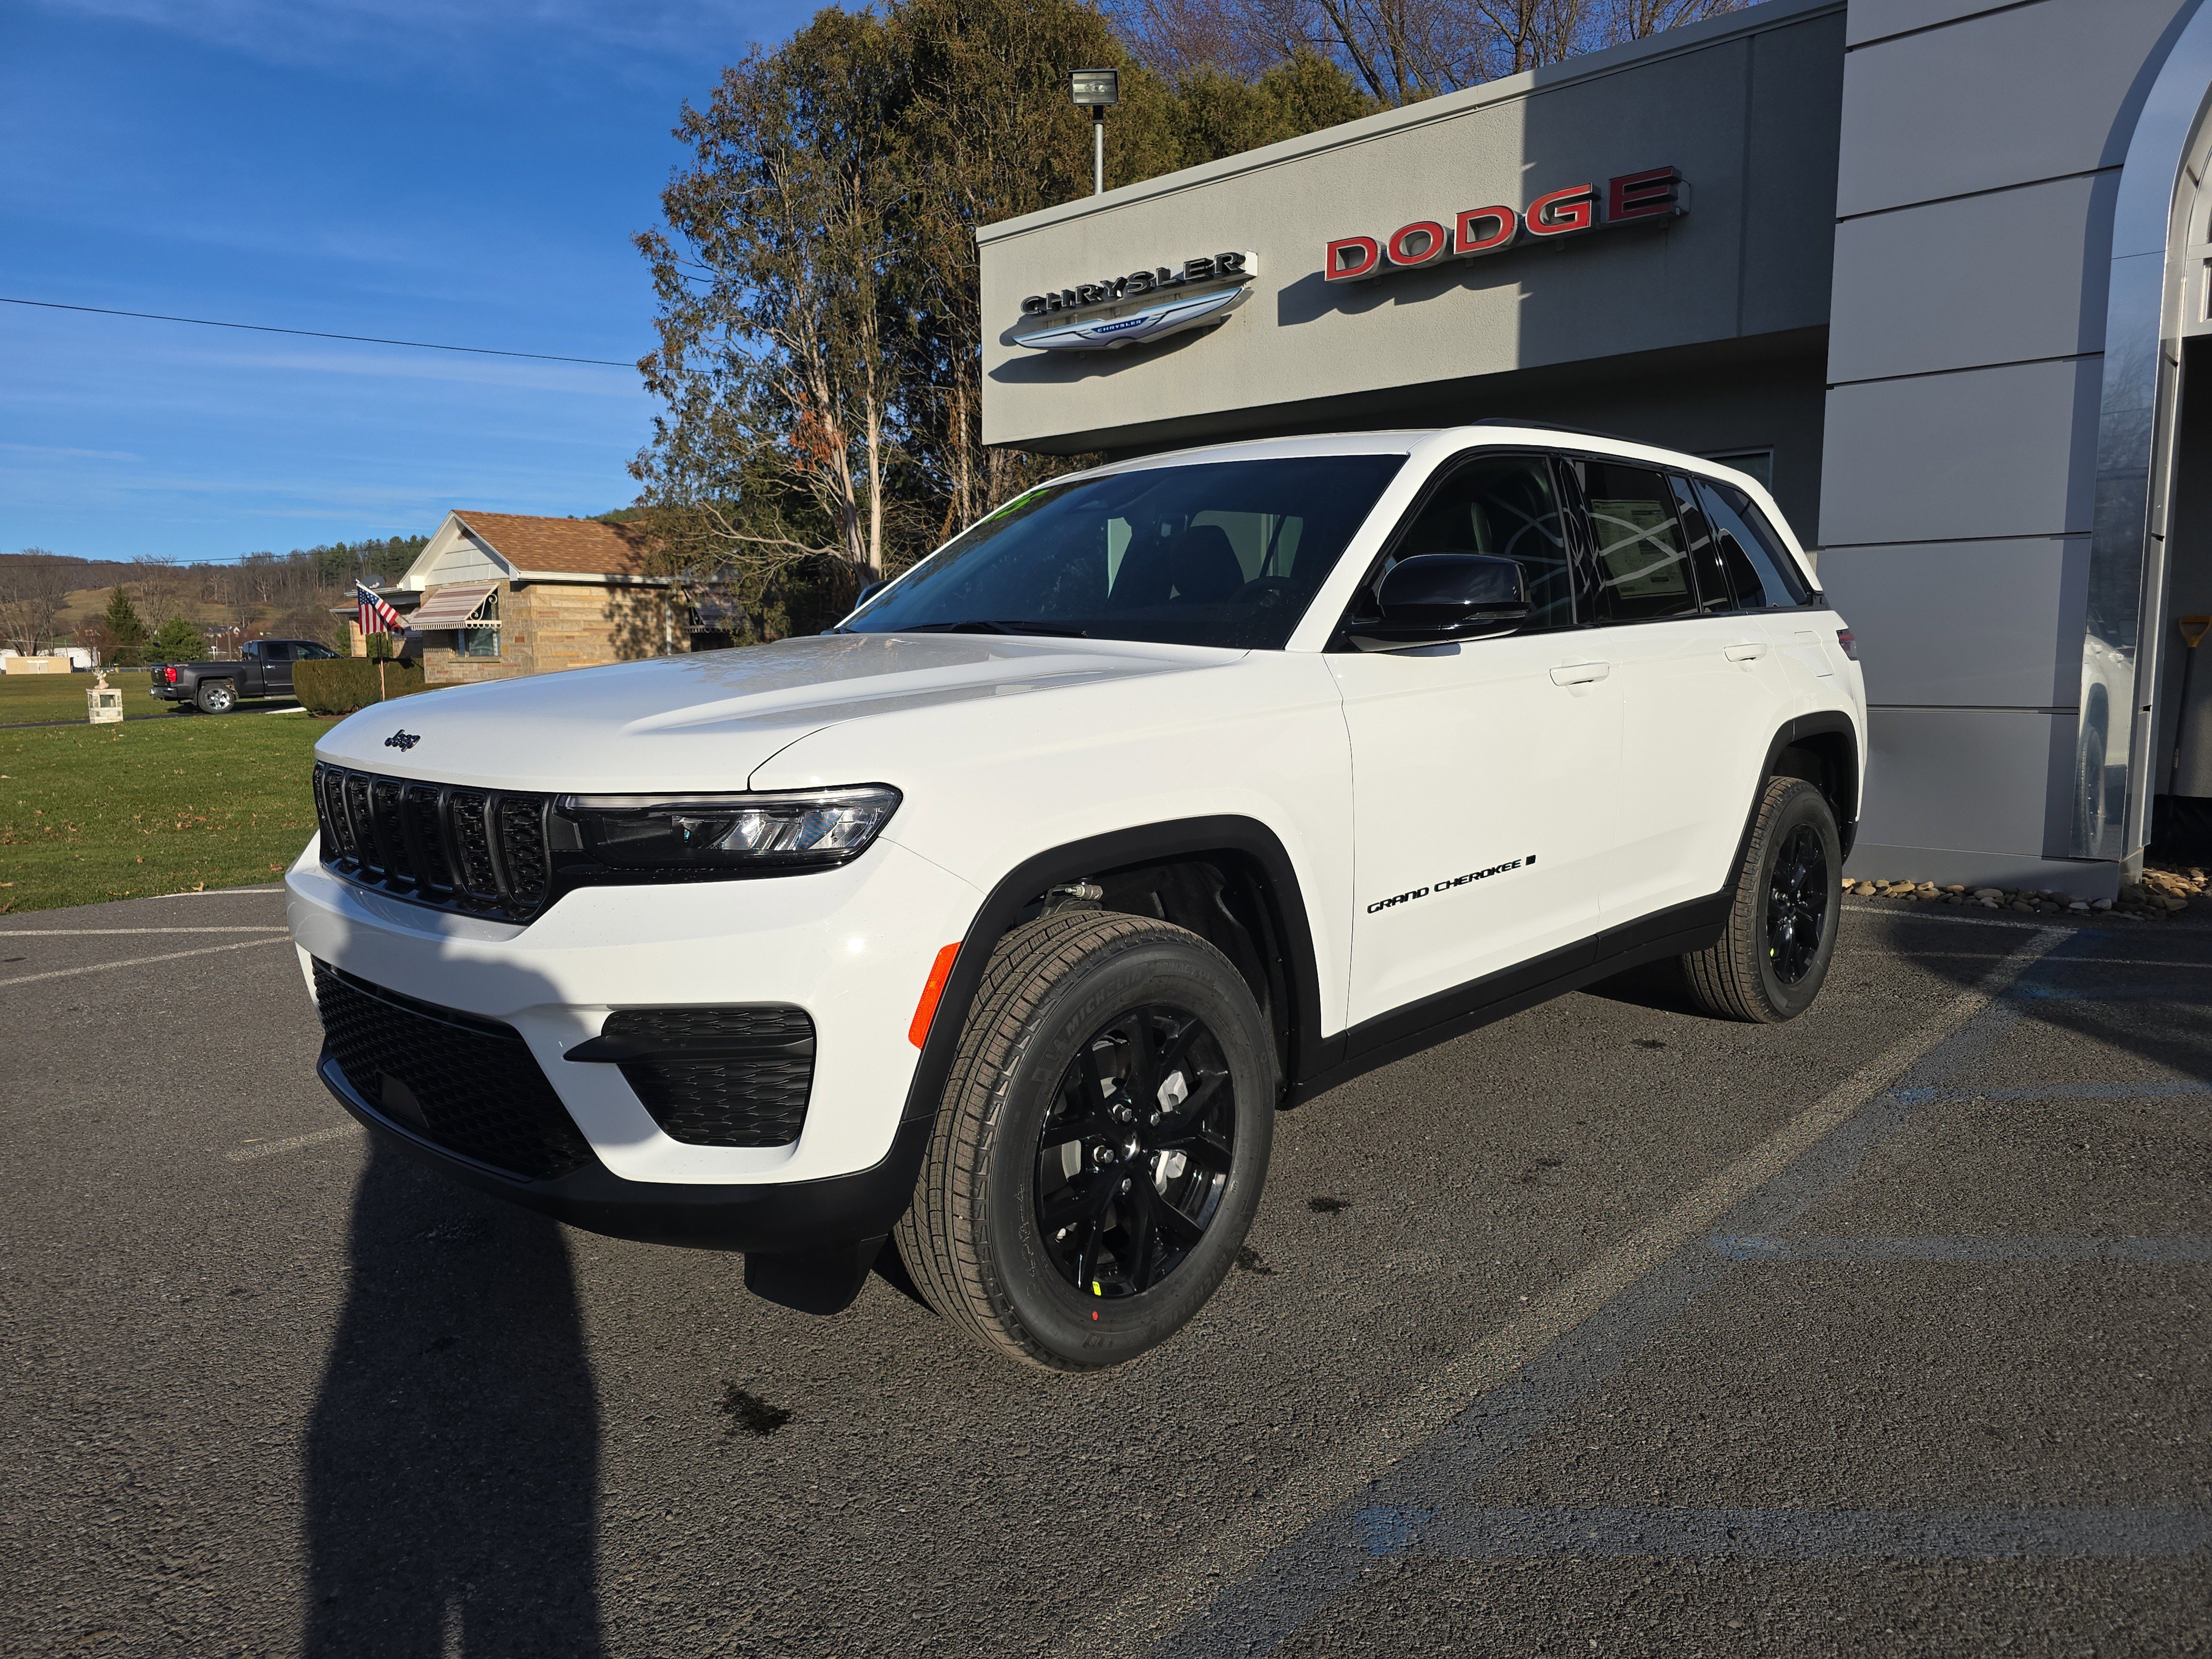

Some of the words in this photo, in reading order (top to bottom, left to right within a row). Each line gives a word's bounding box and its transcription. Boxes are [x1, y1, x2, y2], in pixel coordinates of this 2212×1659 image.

[1324, 166, 1681, 282] DODGE
[1021, 252, 1246, 314] CHRYSLER
[1097, 320, 1141, 332] CHRYSLER
[384, 729, 421, 752] Jeep
[1367, 887, 1429, 914] GRAND
[1433, 859, 1521, 892] CHEROKEE
[1066, 966, 1144, 1038] MICHELIN
